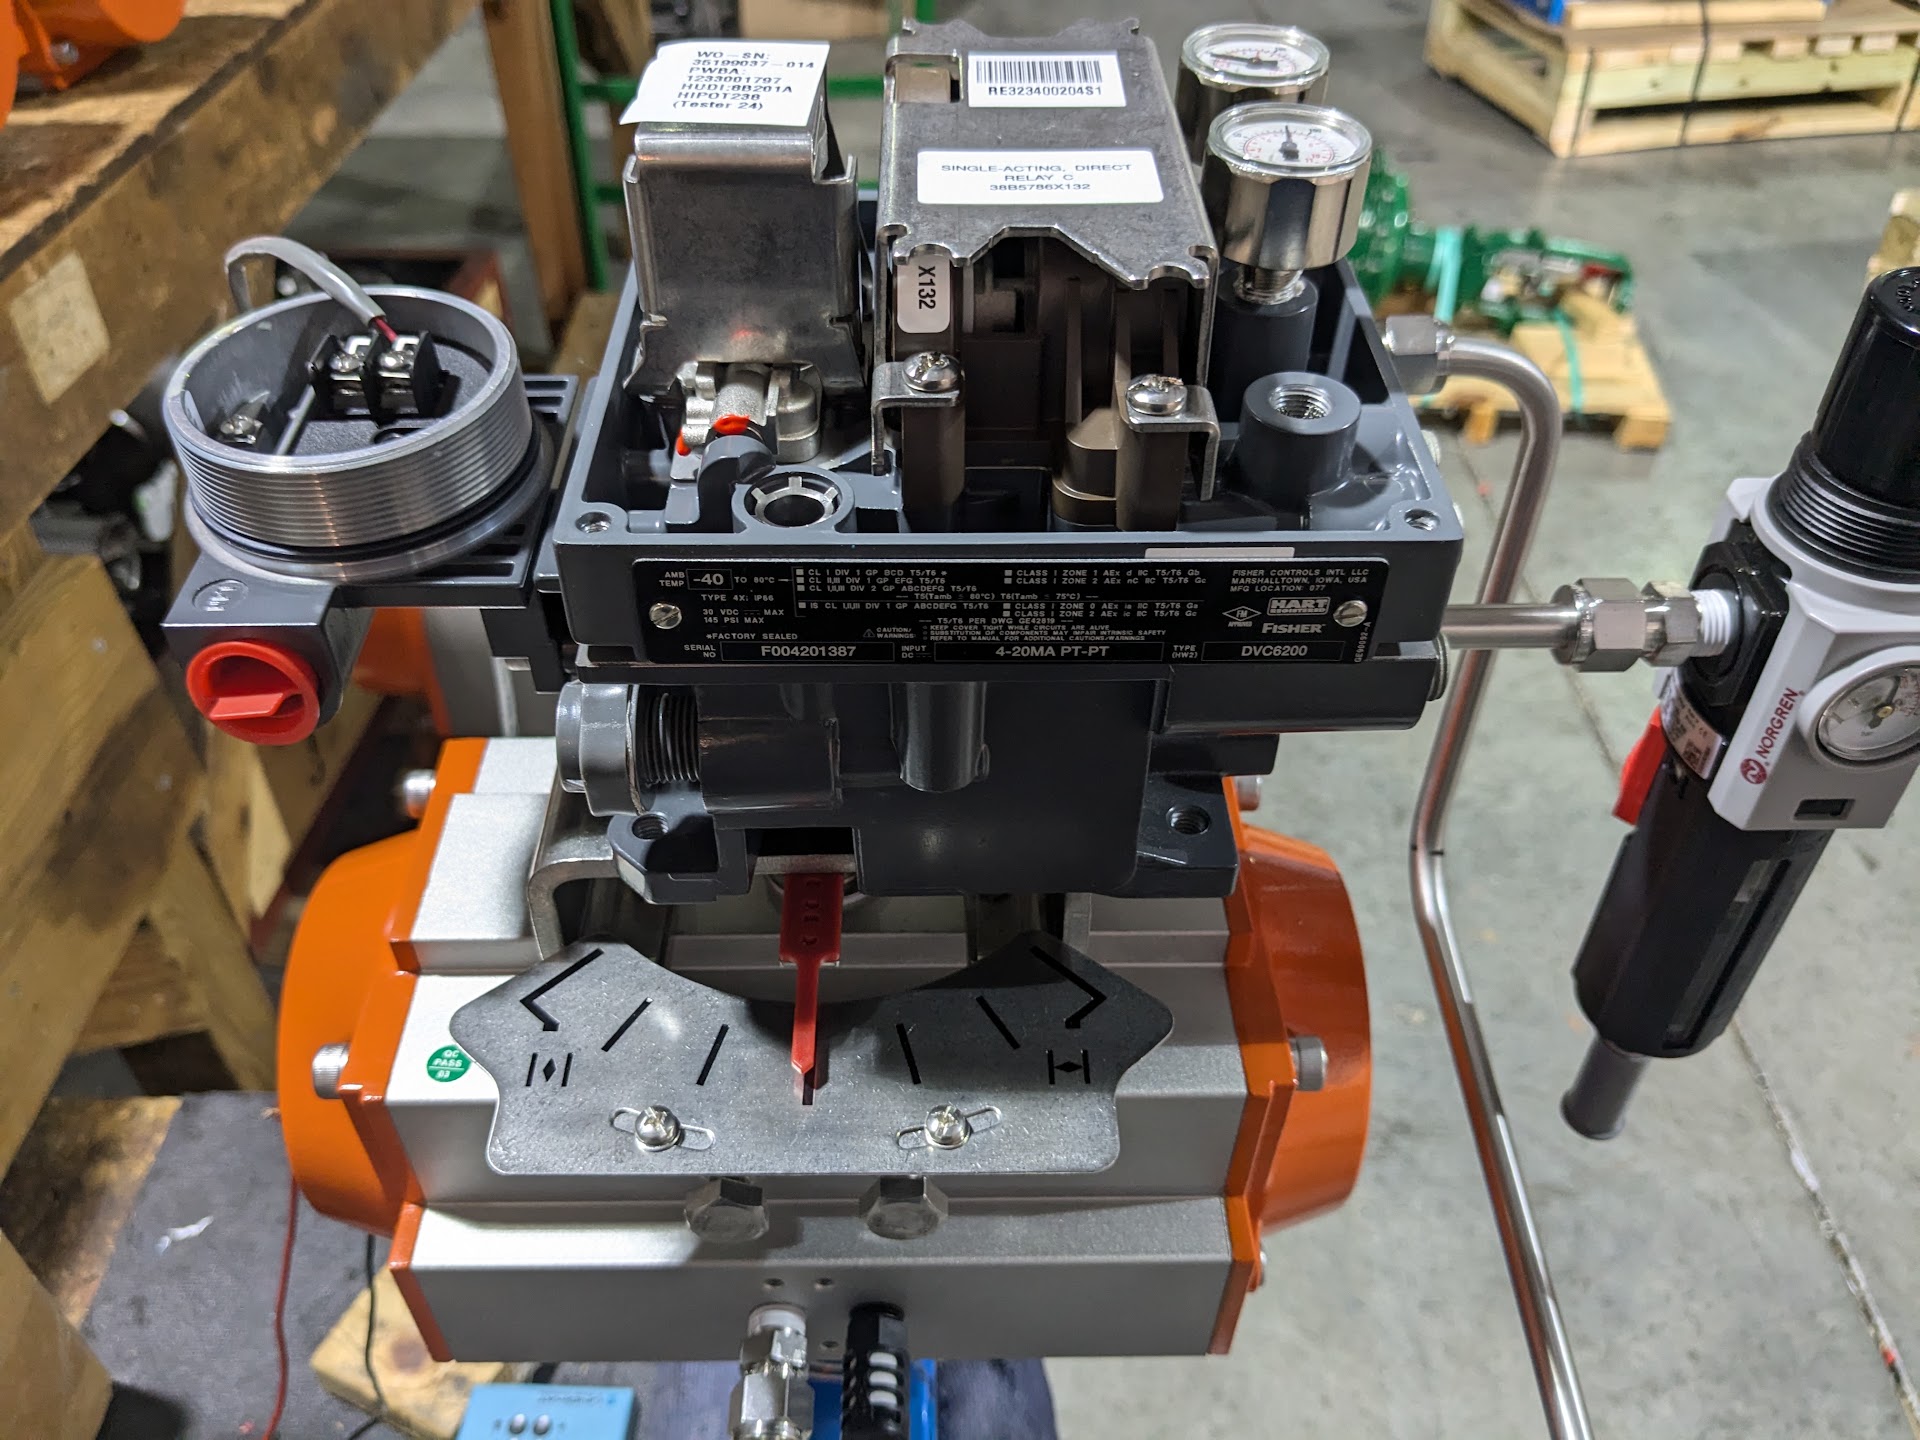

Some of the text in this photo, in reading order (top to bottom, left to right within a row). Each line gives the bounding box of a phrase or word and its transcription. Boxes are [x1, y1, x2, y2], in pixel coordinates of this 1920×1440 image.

[689, 67, 746, 75] PWBA:
[686, 75, 782, 84] 1233001797
[988, 86, 1102, 96] RE323400204S1
[673, 100, 763, 110] (Tester 24)
[941, 164, 1066, 173] SINGLE-ACTING,
[990, 183, 1090, 191] 38B5786X132
[918, 265, 936, 310] X132
[693, 573, 724, 585] -40
[1271, 600, 1328, 609] HART
[1236, 610, 1248, 618] FM
[761, 645, 857, 657] F004201387
[995, 646, 1110, 657] 4-20MA PT-PT
[1171, 651, 1198, 659] (HW2)
[1241, 645, 1308, 657] DVC6200
[1756, 687, 1799, 759] NORGREN
[442, 1049, 460, 1058] QC
[432, 1058, 463, 1067] PASS
